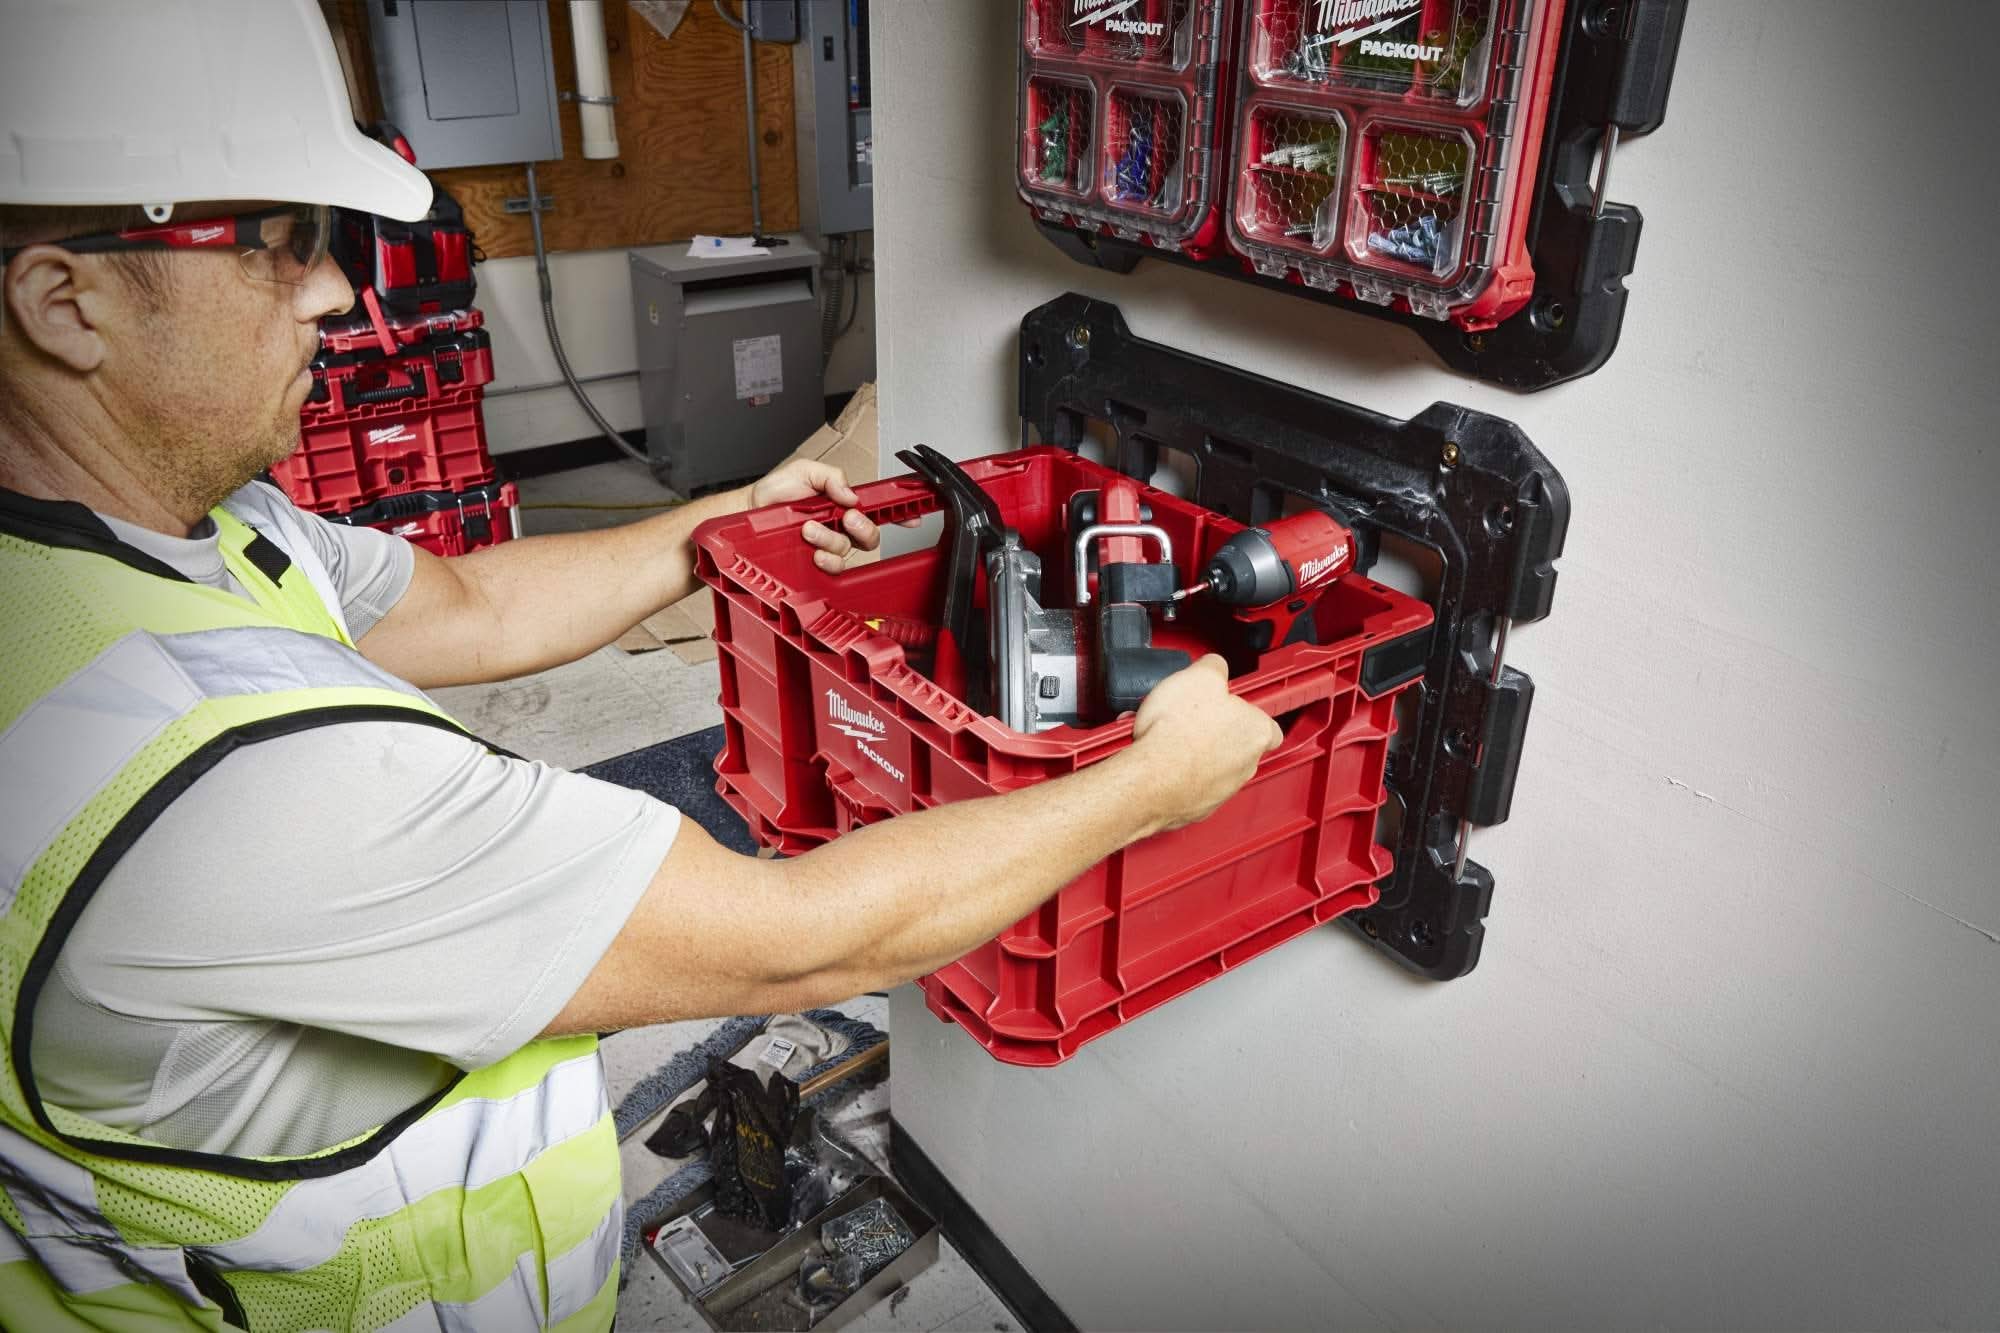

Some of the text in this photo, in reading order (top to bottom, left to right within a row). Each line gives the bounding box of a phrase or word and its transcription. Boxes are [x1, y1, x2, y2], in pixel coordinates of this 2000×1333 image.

[1105, 19, 1163, 36] PACKOUT
[1360, 40, 1443, 61] PACKOUT
[825, 688, 886, 733] Milwaukee
[857, 739, 904, 782] PACKOUT
